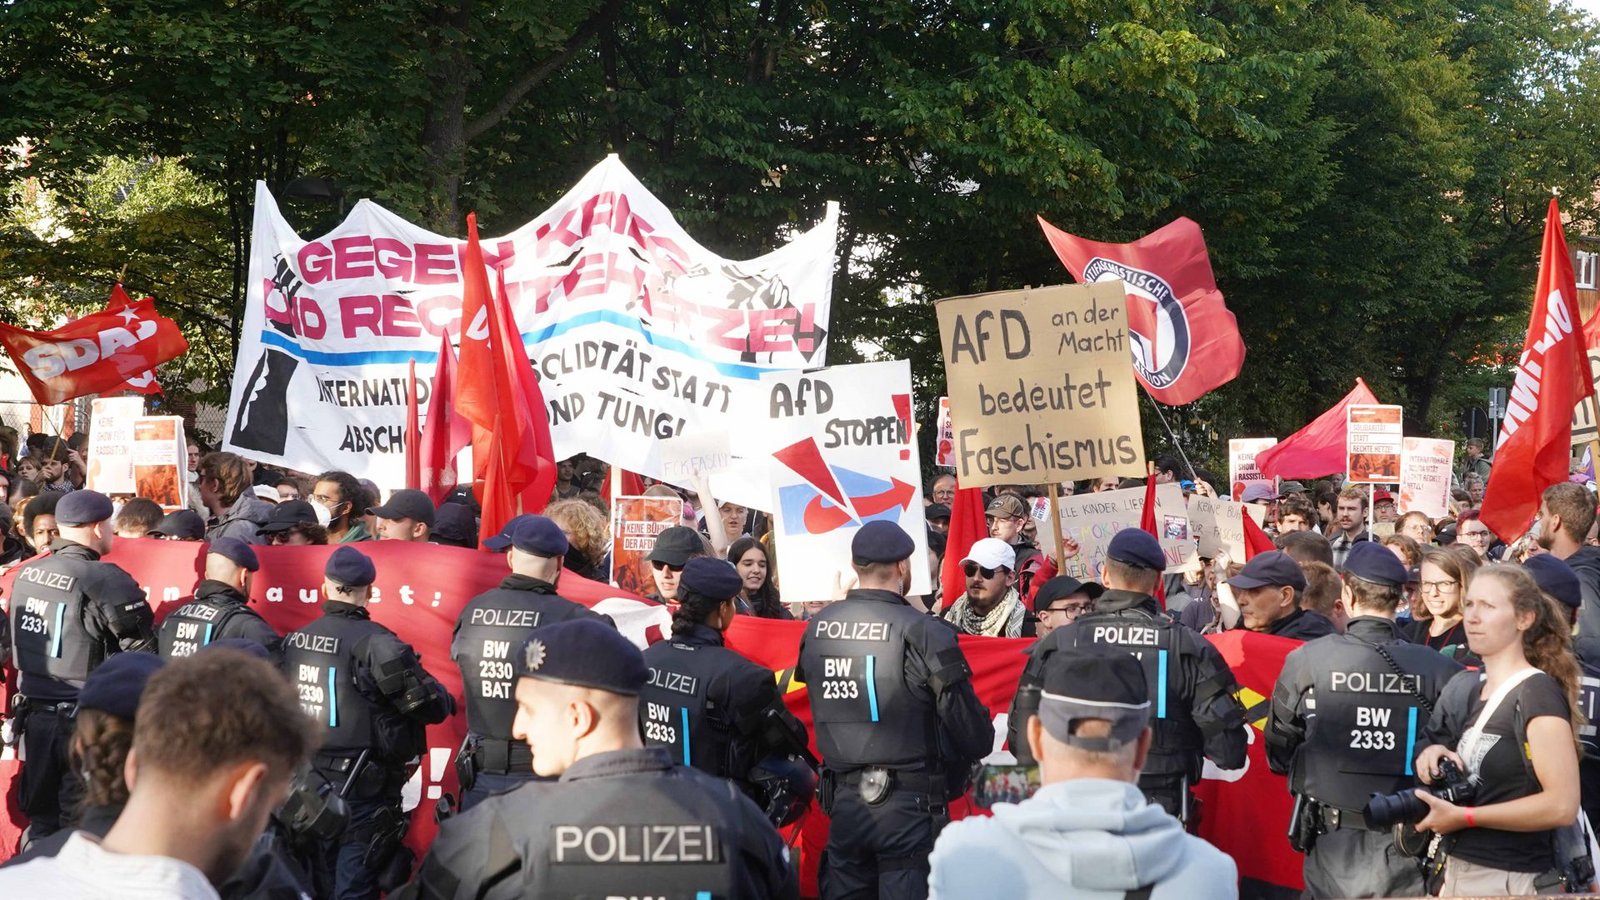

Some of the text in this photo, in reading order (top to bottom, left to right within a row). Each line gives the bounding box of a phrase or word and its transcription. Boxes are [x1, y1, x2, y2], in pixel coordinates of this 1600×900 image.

[951, 298, 1119, 365] AfD an der
[1058, 328, 1125, 356] Macht
[652, 366, 732, 413] STATT
[769, 378, 834, 418] AfD
[979, 368, 1112, 416] bedeutet
[548, 392, 586, 426] ND
[959, 423, 1138, 478] Faschismus
[1238, 473, 1266, 481] RASSISTE
[1082, 502, 1119, 515] KINDER
[1124, 497, 1161, 511] LIEBN
[626, 523, 644, 534] KEINE
[625, 538, 638, 549] DER
[19, 566, 74, 591] POLIZEI
[25, 597, 48, 616] BW
[174, 604, 218, 621] POLIZEI
[21, 615, 48, 636] 2331
[471, 608, 540, 627] POLIZEI
[176, 622, 198, 640] BW
[816, 620, 888, 640] POLIZEI
[1093, 626, 1159, 646] POLIZEI
[288, 632, 338, 654] POLIZEI
[482, 640, 510, 659] BW
[299, 664, 320, 684] BW
[480, 661, 513, 680] 2330
[824, 658, 852, 678] BW
[481, 681, 512, 699] BAT
[645, 667, 697, 695] OLIZEI
[822, 680, 859, 699] 2333
[1331, 672, 1421, 694] POLIZEI
[297, 684, 323, 703] 2330
[647, 702, 670, 722] BW
[1356, 707, 1391, 727] BW
[645, 721, 676, 744] 2333
[1350, 730, 1395, 750] 2333
[555, 825, 713, 862] POLIZEI
